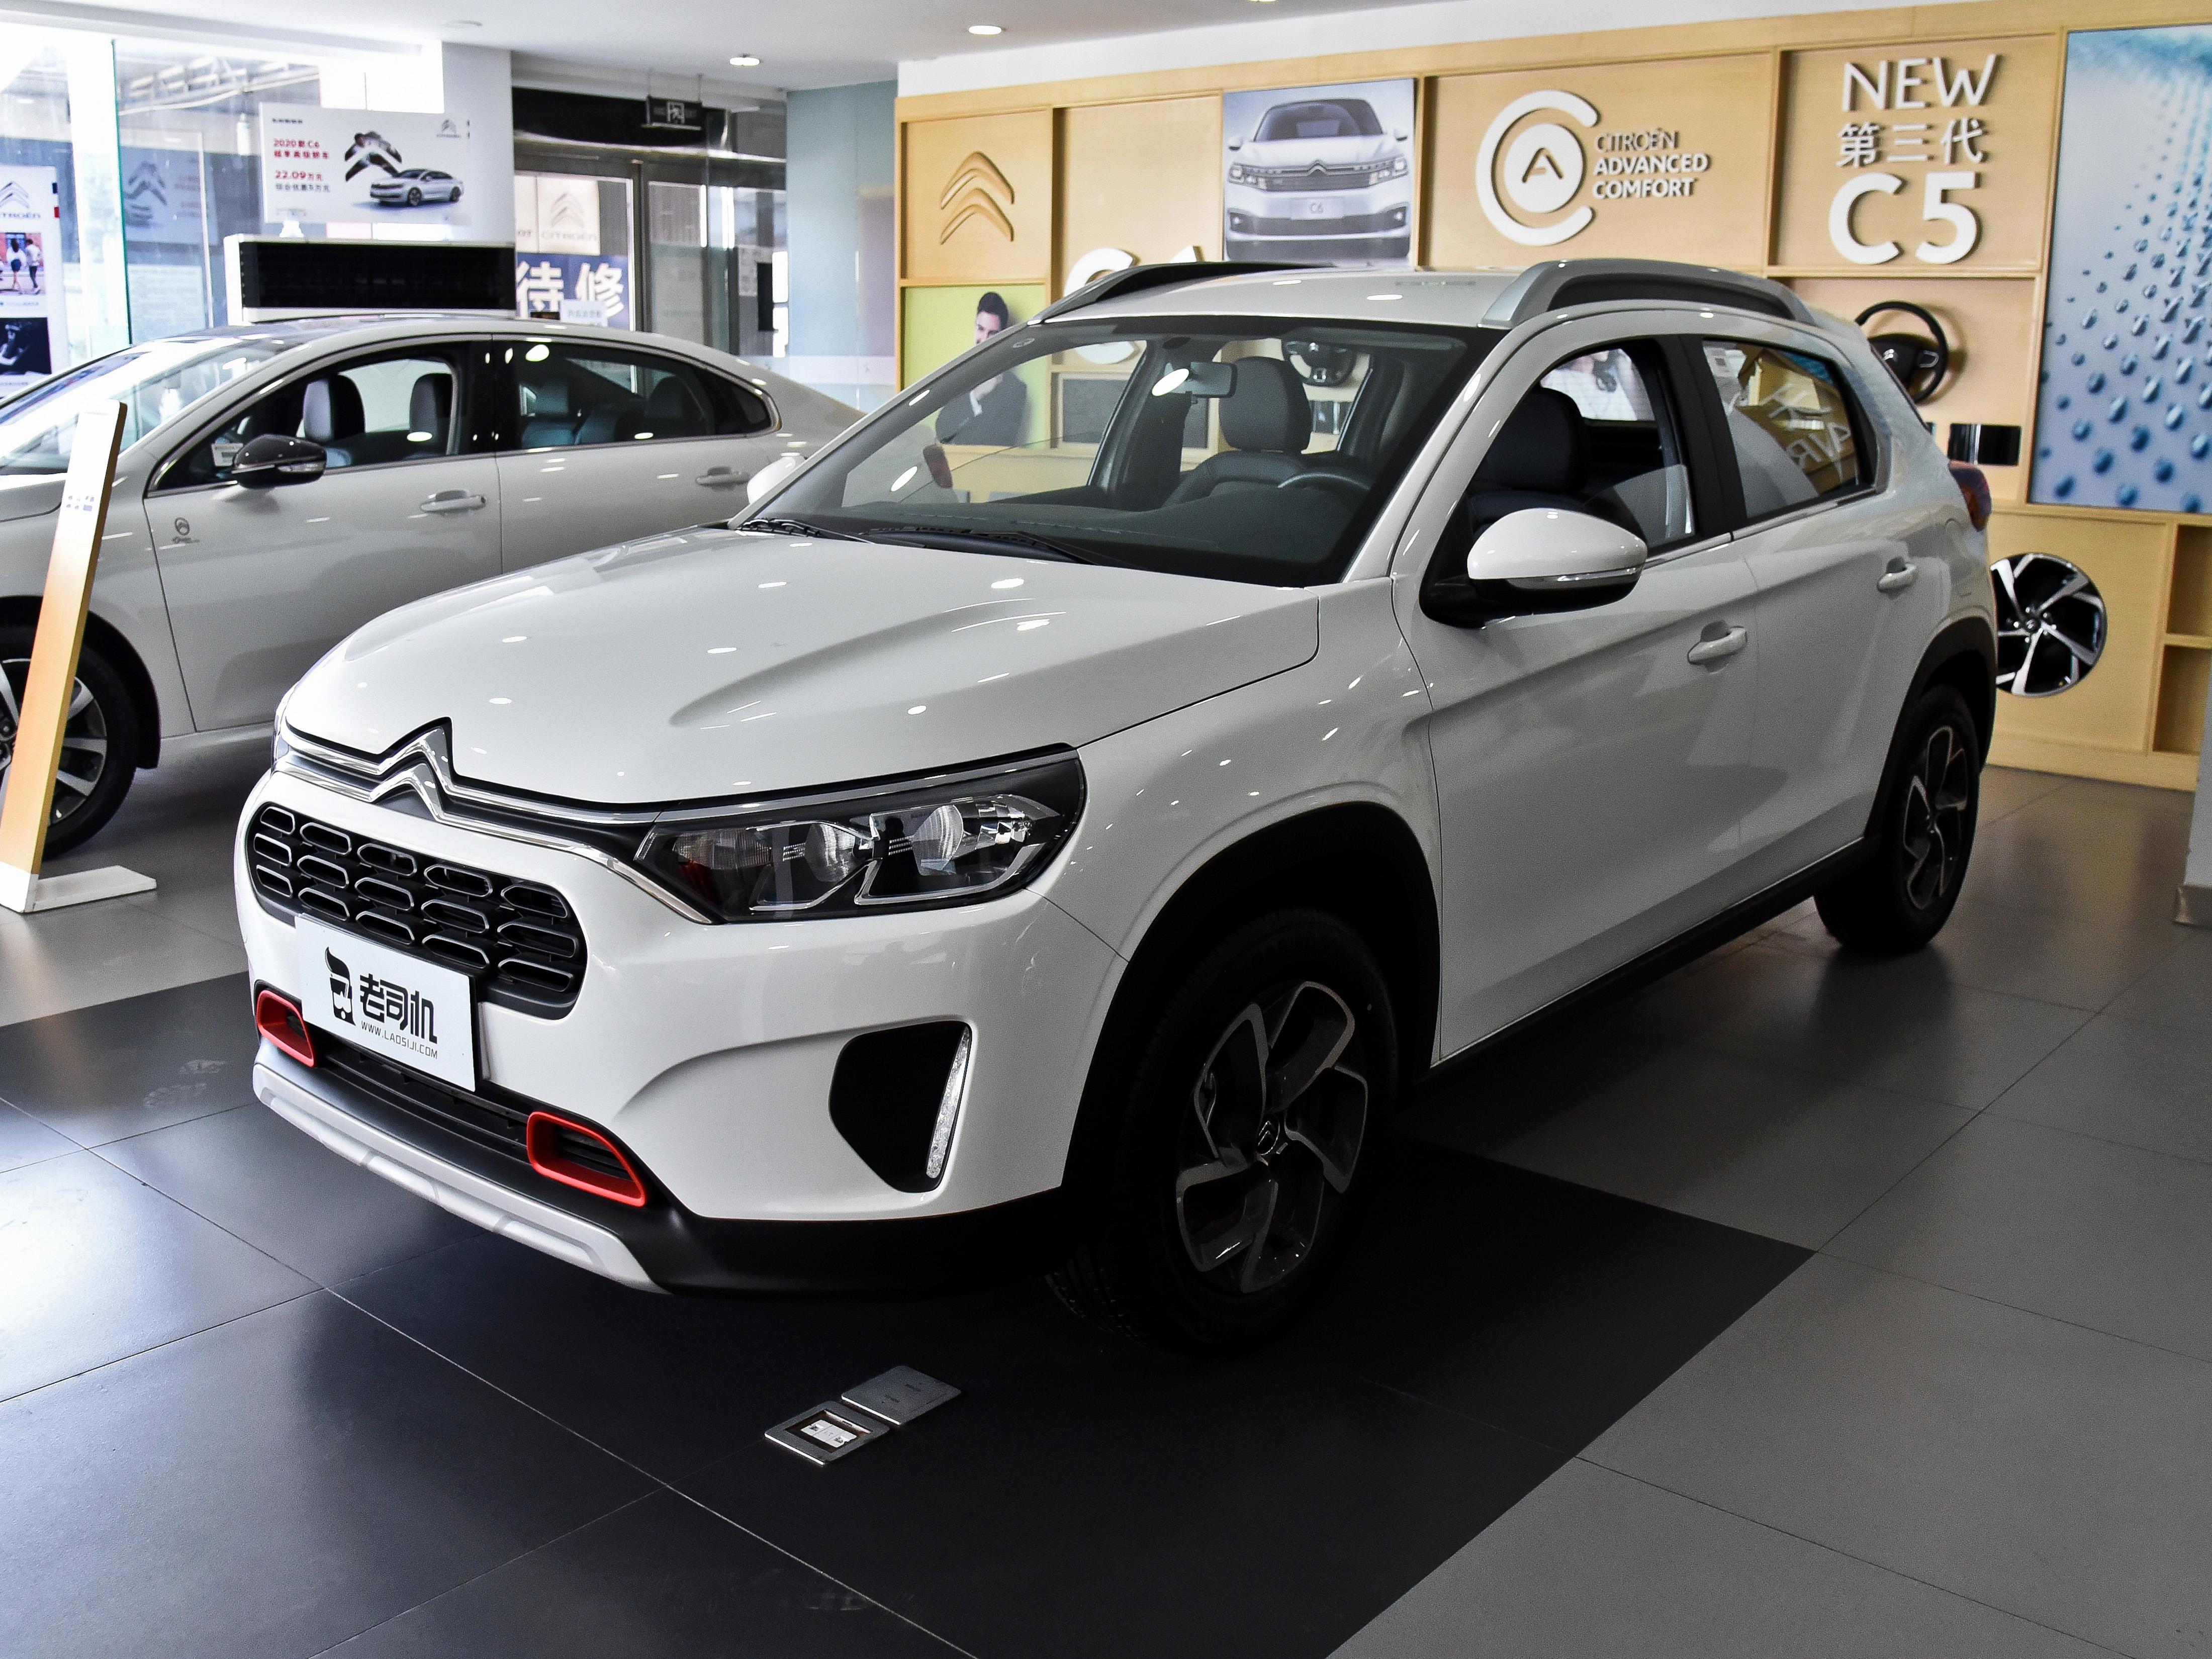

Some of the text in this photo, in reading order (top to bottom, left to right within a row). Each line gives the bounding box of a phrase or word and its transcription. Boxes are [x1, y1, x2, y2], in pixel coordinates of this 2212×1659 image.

[1842, 54, 1996, 112] NEW
[1836, 117, 1984, 167] 第三代
[1593, 153, 1709, 176] ADVANCED
[1310, 202, 1324, 214] C6
[1592, 177, 1694, 199] COMFORT
[1828, 171, 1979, 265] C5
[360, 973, 437, 1044] 老司机
[361, 1020, 438, 1059] WWW.LAOSIJI.COM
